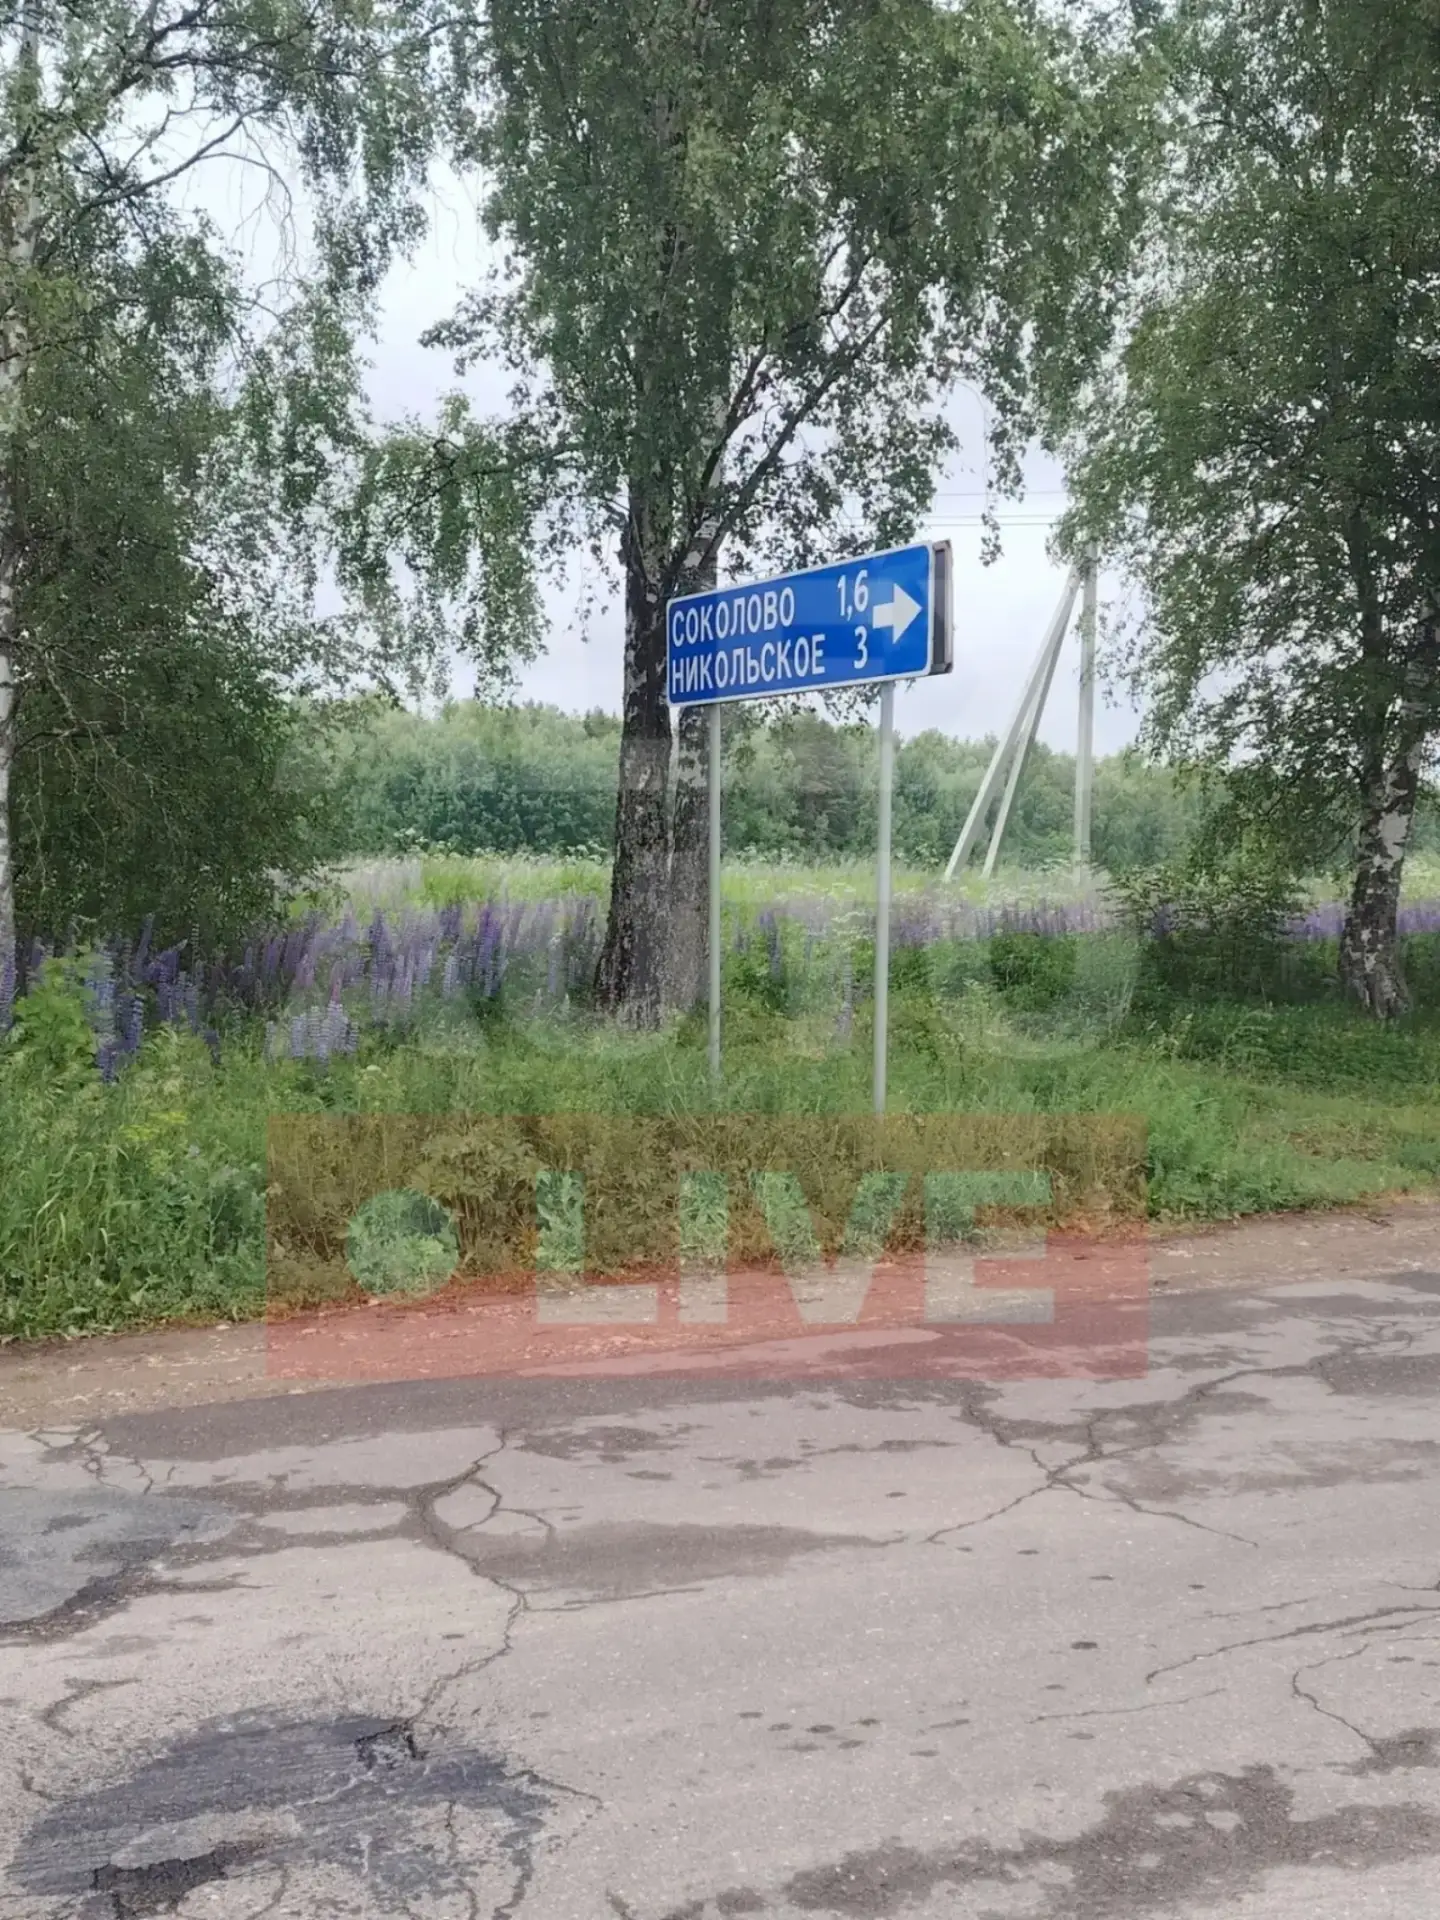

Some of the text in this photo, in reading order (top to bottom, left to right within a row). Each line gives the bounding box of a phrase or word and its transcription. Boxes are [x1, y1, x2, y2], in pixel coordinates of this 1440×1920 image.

[671, 569, 869, 647] СОКОЛОВО 1,6
[671, 626, 868, 695] НИКОЛЬСКОЕ 3
